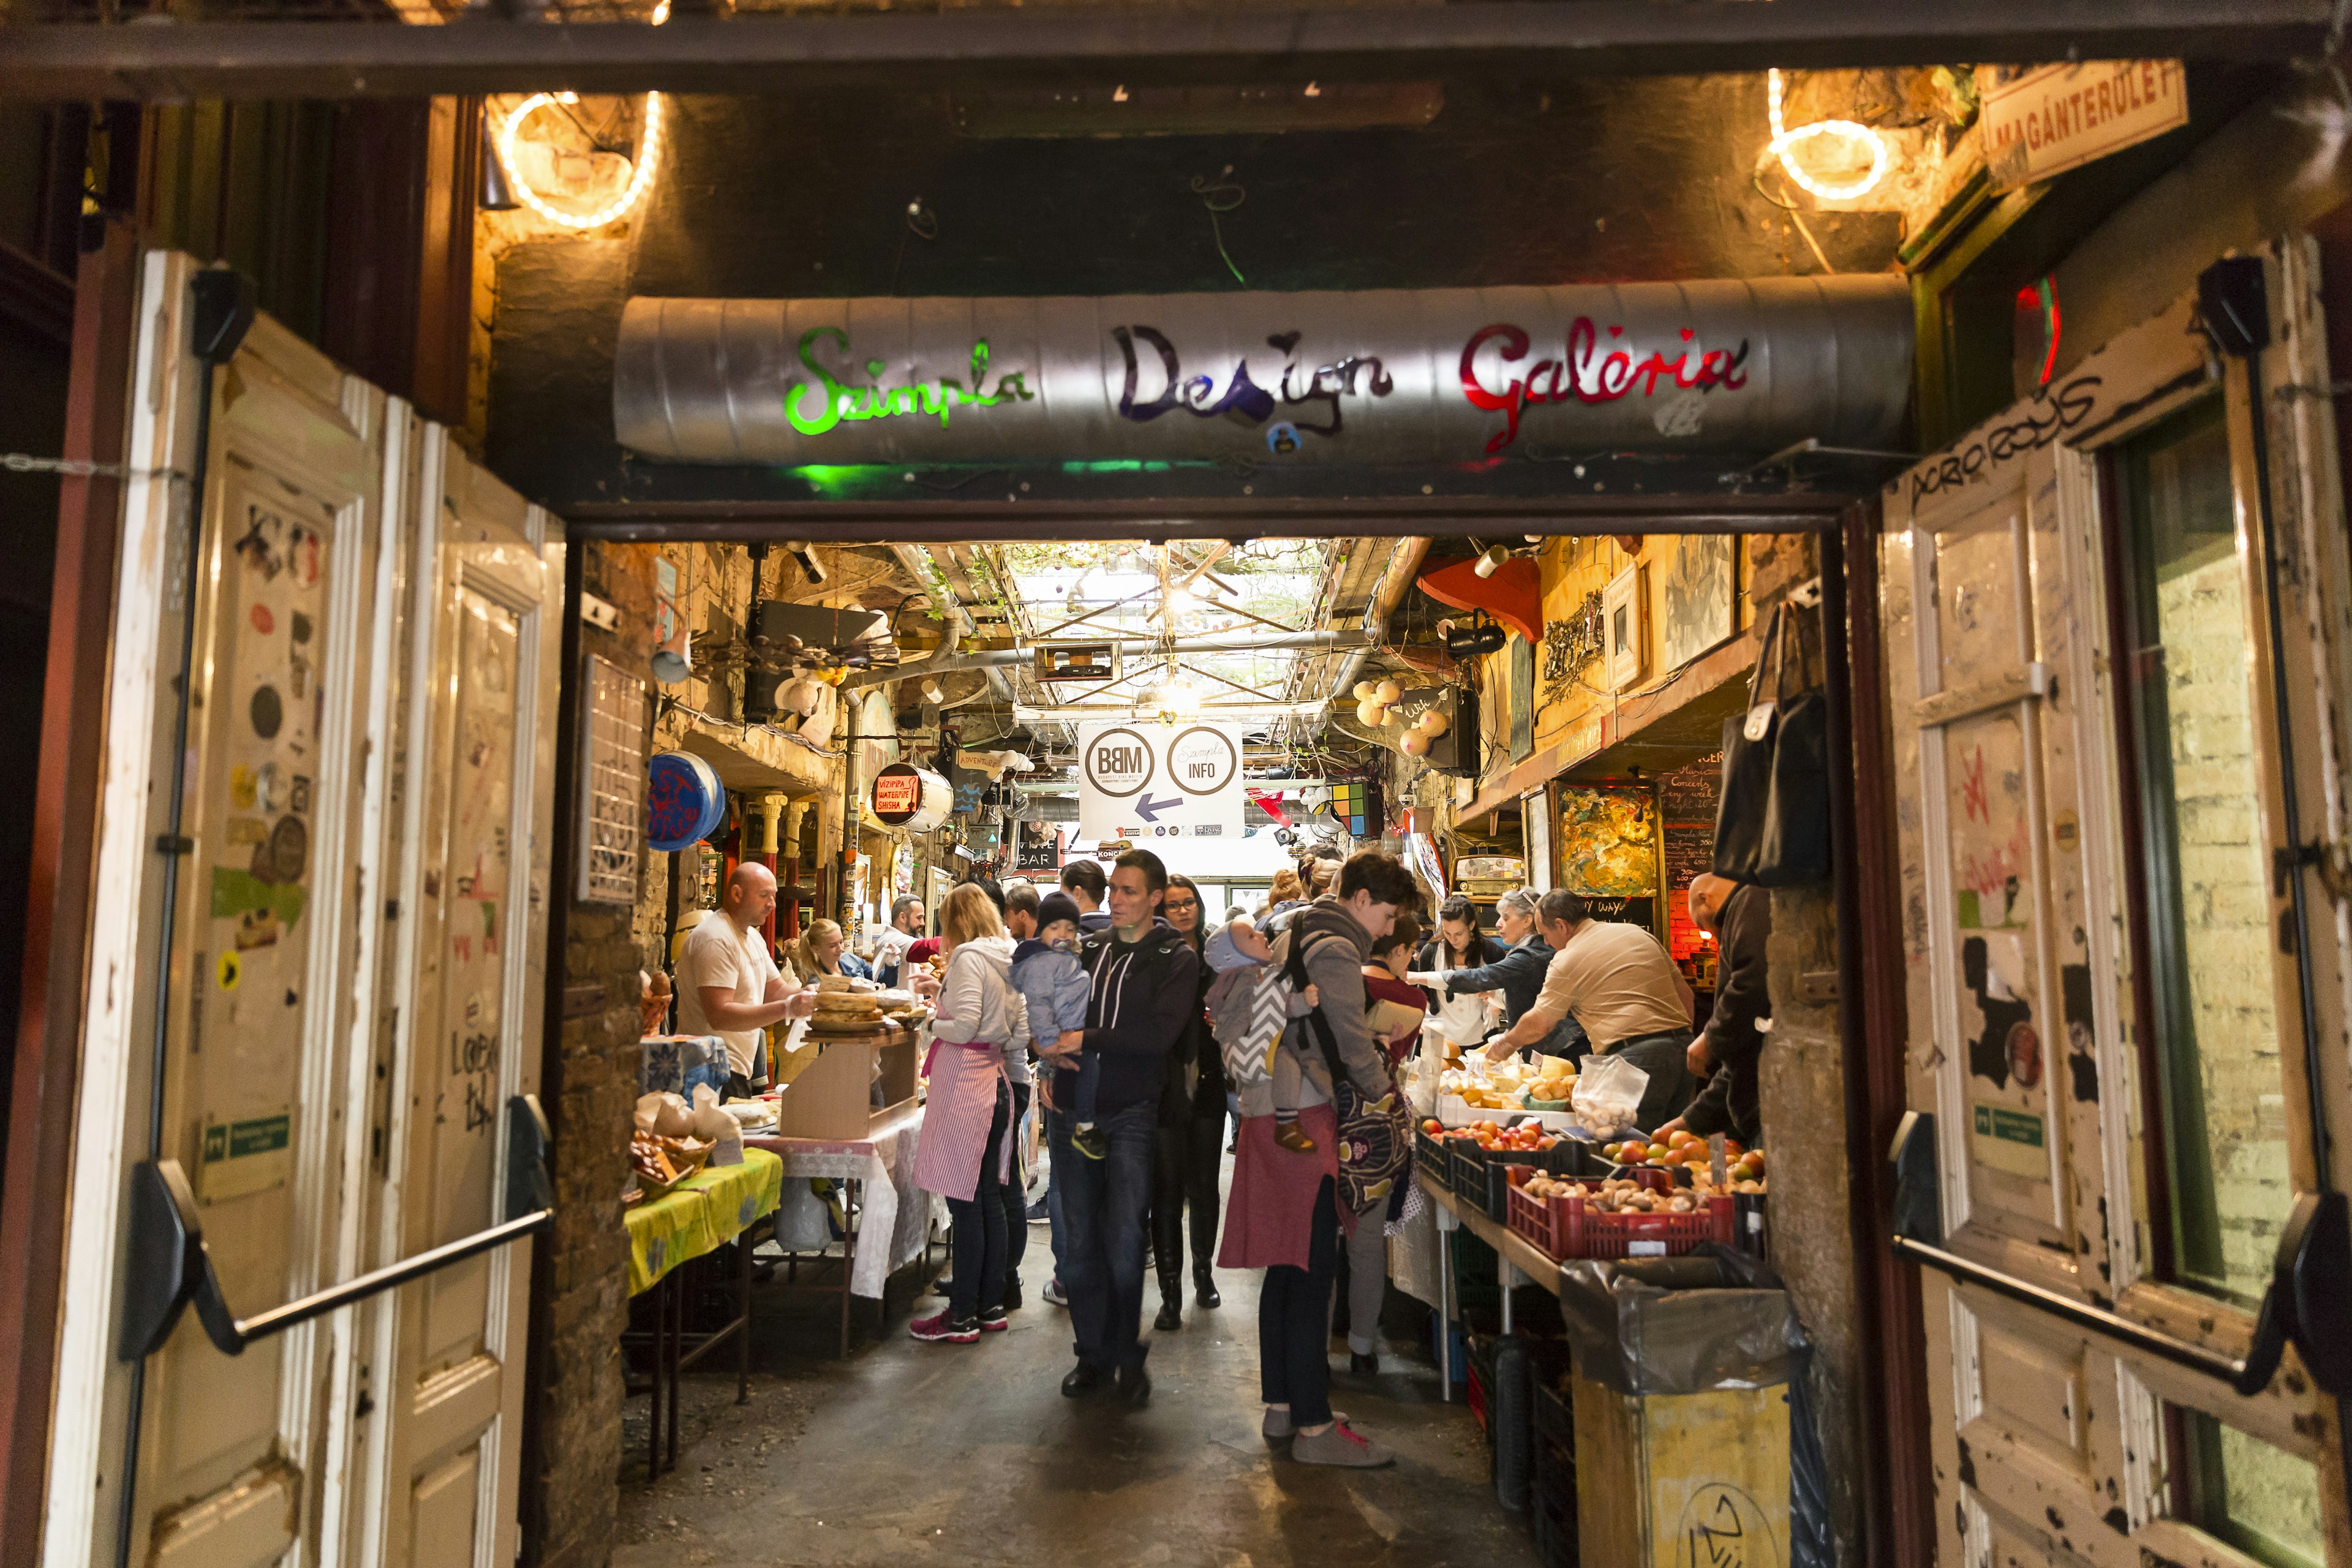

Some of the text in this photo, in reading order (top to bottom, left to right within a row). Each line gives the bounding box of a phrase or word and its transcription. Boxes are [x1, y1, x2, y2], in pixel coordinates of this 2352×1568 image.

[785, 326, 1033, 435] Szimpla
[1111, 325, 1393, 435] Design
[1405, 699, 1430, 718] Wifi
[1098, 747, 1142, 774] BBM
[1177, 742, 1224, 763] Szimpla
[1189, 763, 1215, 778] INFO
[1019, 854, 1050, 865] BAR
